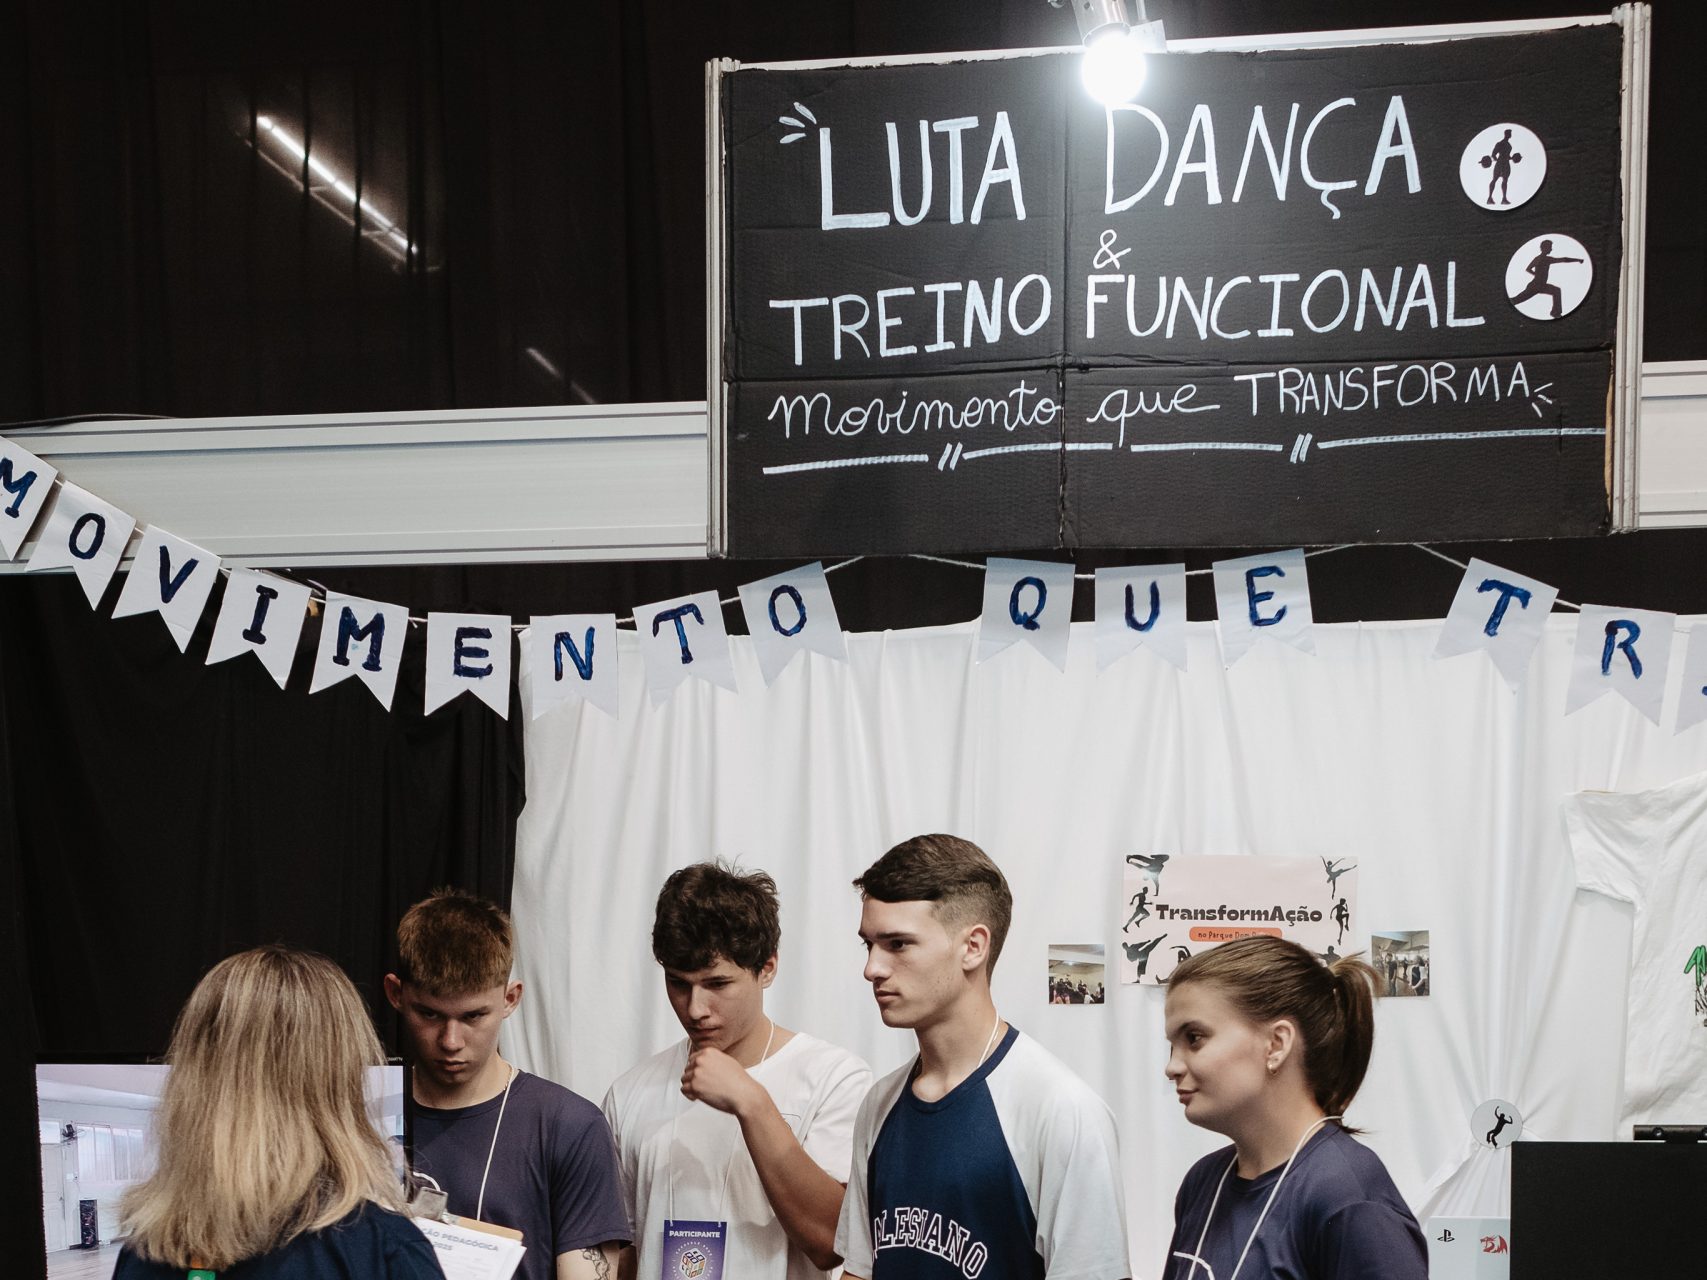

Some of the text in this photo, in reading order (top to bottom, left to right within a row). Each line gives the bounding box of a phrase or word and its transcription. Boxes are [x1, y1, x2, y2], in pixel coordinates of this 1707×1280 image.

[818, 95, 1422, 230] LUTA DANÇA
[1091, 228, 1131, 270] &
[768, 261, 1486, 366] TREINO FUNCIONAL
[1085, 381, 1222, 447] que
[1234, 362, 1532, 417] TRANSFORMA
[1008, 565, 1288, 632] QUE
[1476, 579, 1707, 696] TR
[1155, 904, 1323, 926] TransformAção
[1208, 931, 1233, 940] Parque
[669, 1230, 720, 1238] PARTICIPANTE
[873, 1207, 988, 1280] ALESIANO
